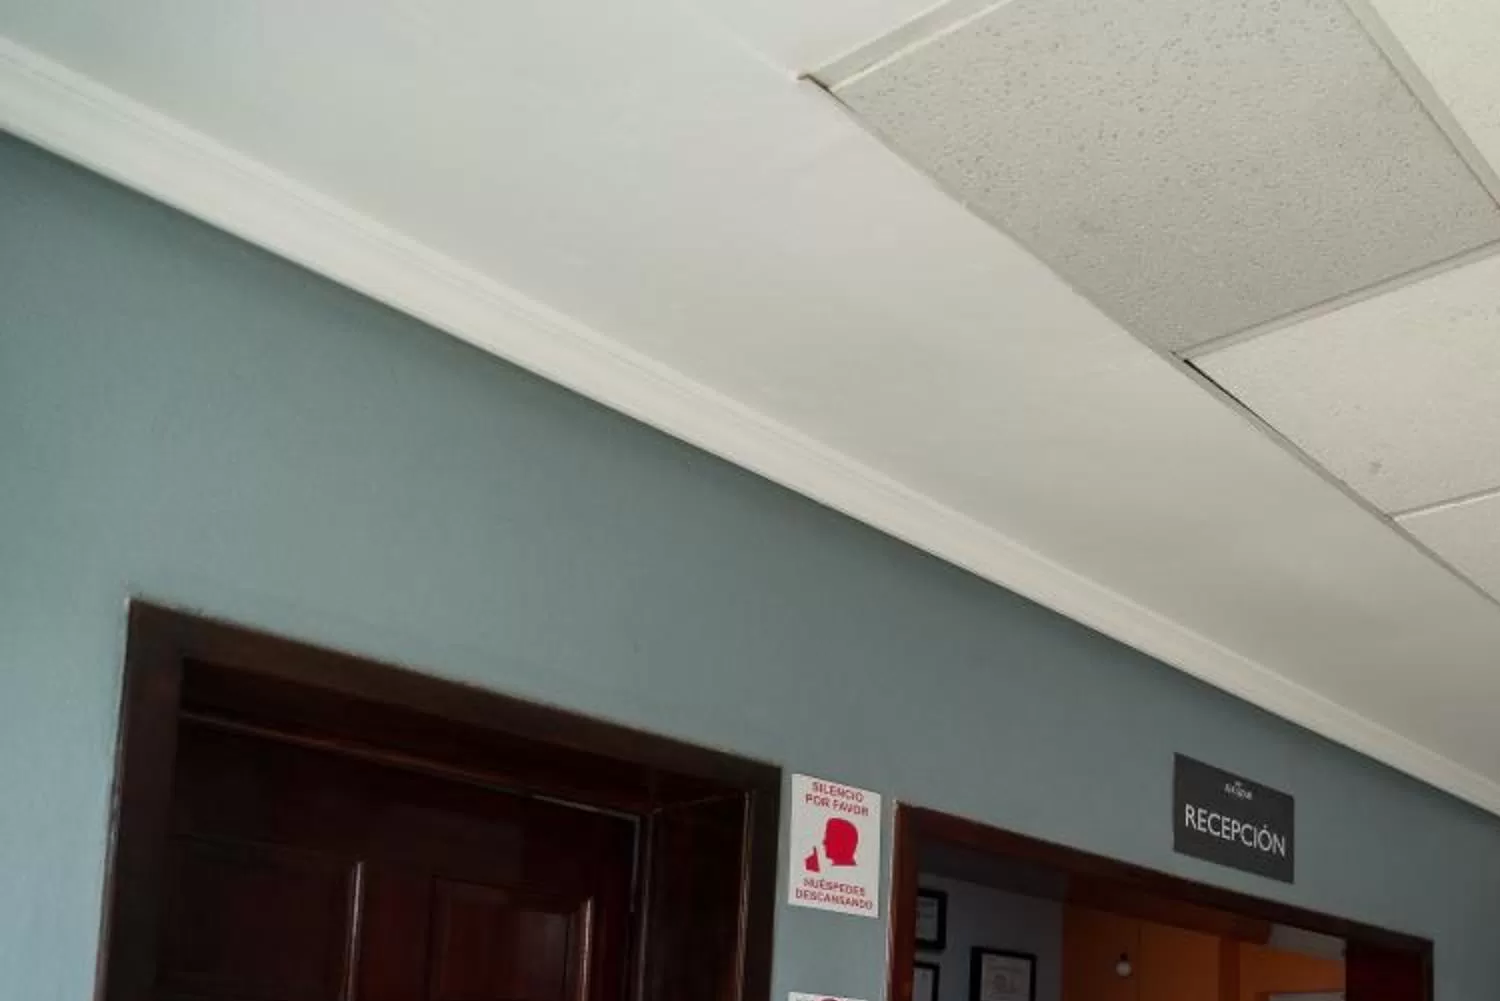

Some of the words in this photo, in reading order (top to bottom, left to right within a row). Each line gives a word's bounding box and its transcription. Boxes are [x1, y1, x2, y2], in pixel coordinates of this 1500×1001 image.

[811, 781, 864, 802] SILENCIO
[805, 793, 829, 808] POR
[833, 798, 869, 817] FAVOR
[1184, 803, 1286, 858] RECEPCIÓN
[795, 887, 873, 910] DESCANSANDO
